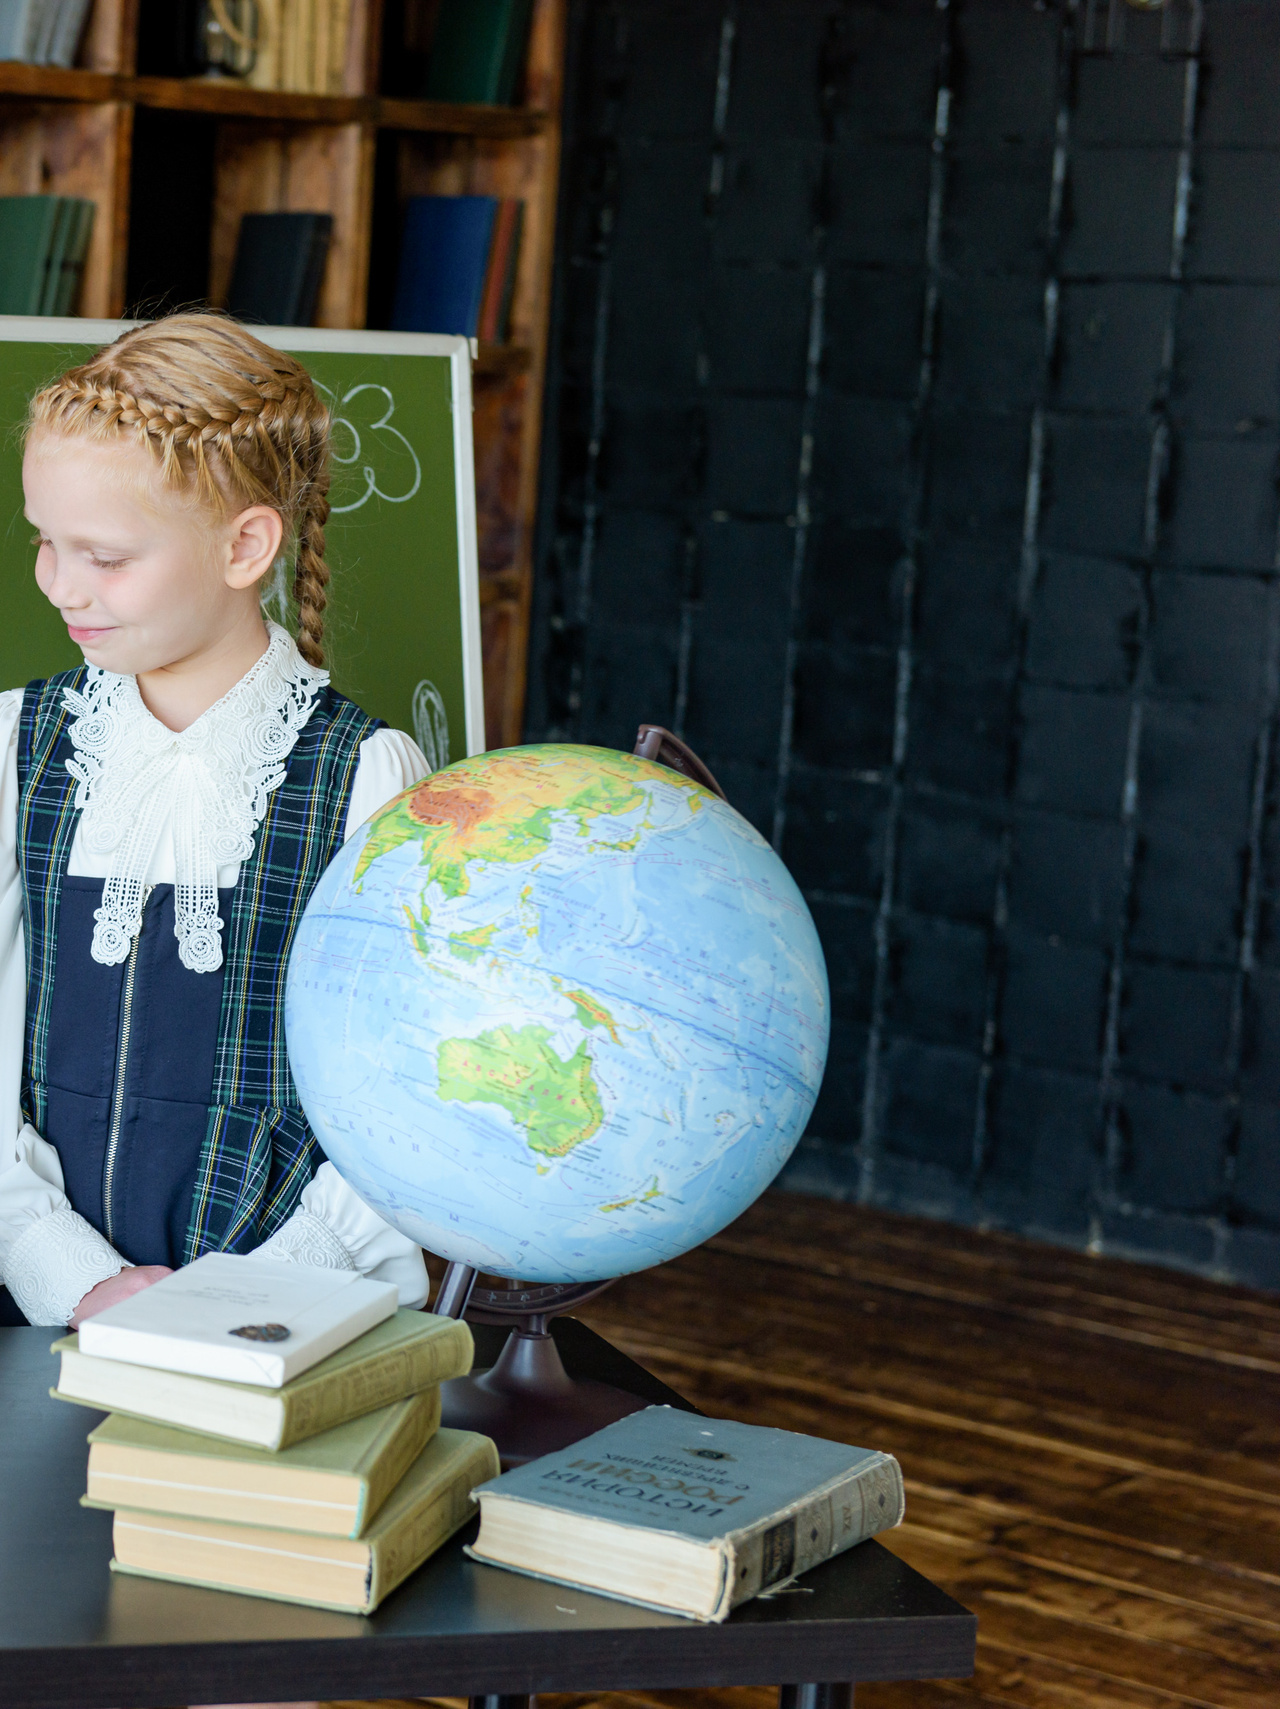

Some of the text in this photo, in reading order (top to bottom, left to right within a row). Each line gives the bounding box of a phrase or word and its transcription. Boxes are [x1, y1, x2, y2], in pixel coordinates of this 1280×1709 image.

[332, 1114, 420, 1153] ОКЕАН
[541, 1468, 724, 1518] ИСТОРИЯ
[566, 1458, 745, 1506] РОССИИ
